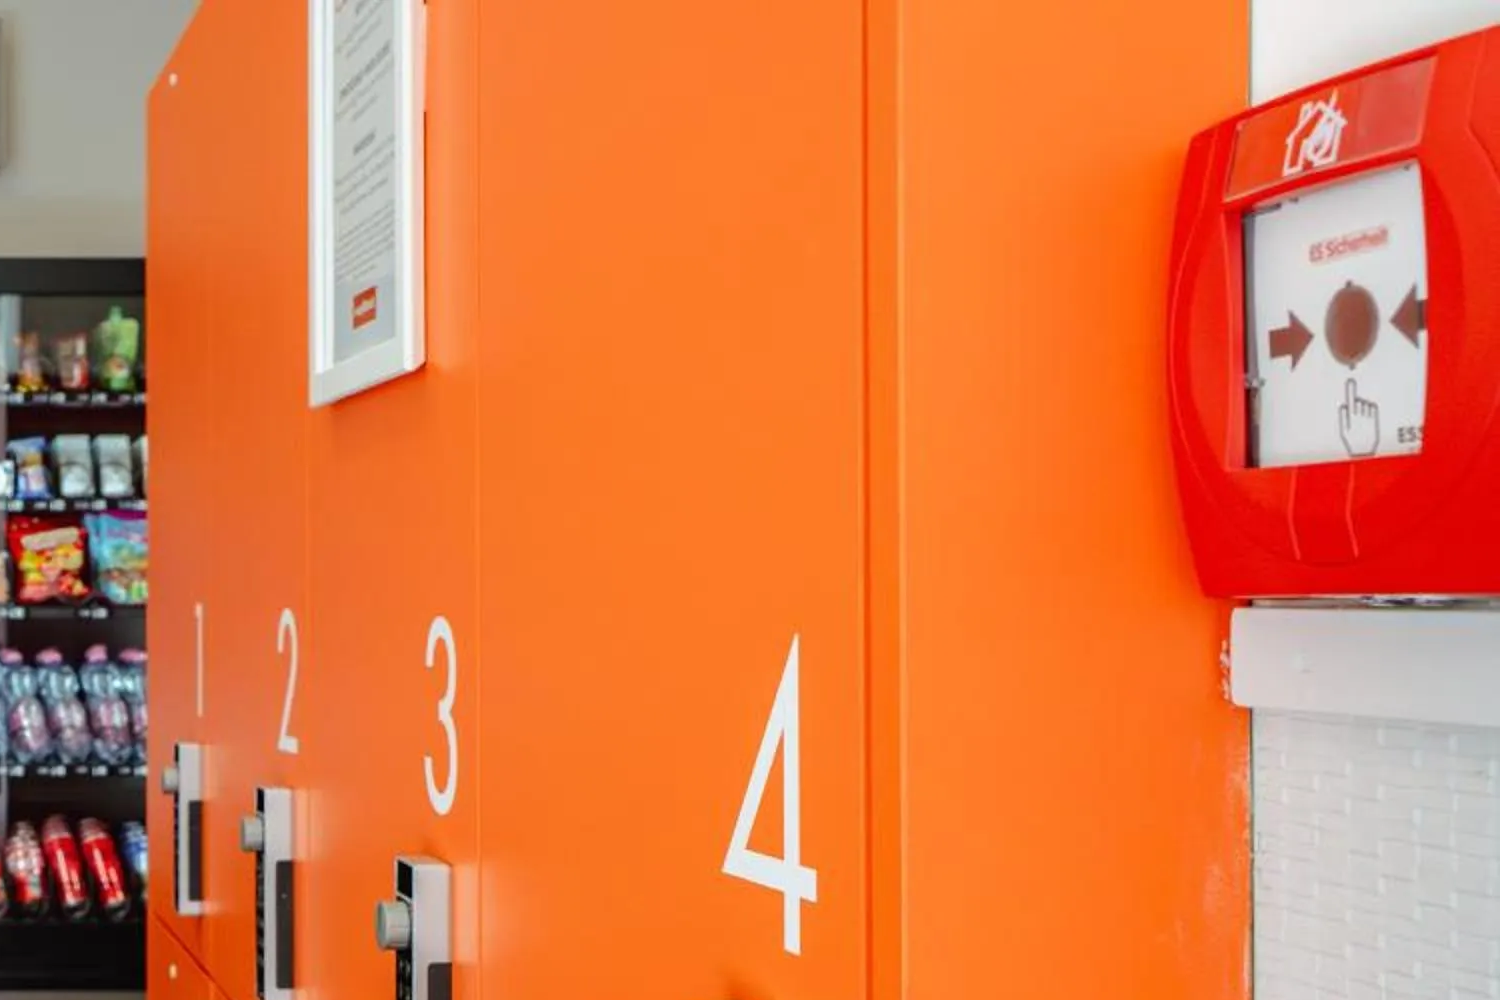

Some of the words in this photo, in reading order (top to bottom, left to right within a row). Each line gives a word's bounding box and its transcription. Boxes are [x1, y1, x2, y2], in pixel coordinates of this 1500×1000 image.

[194, 602, 203, 718] 1
[277, 607, 299, 755] 2
[423, 615, 459, 815] 3
[721, 632, 818, 957] 4
